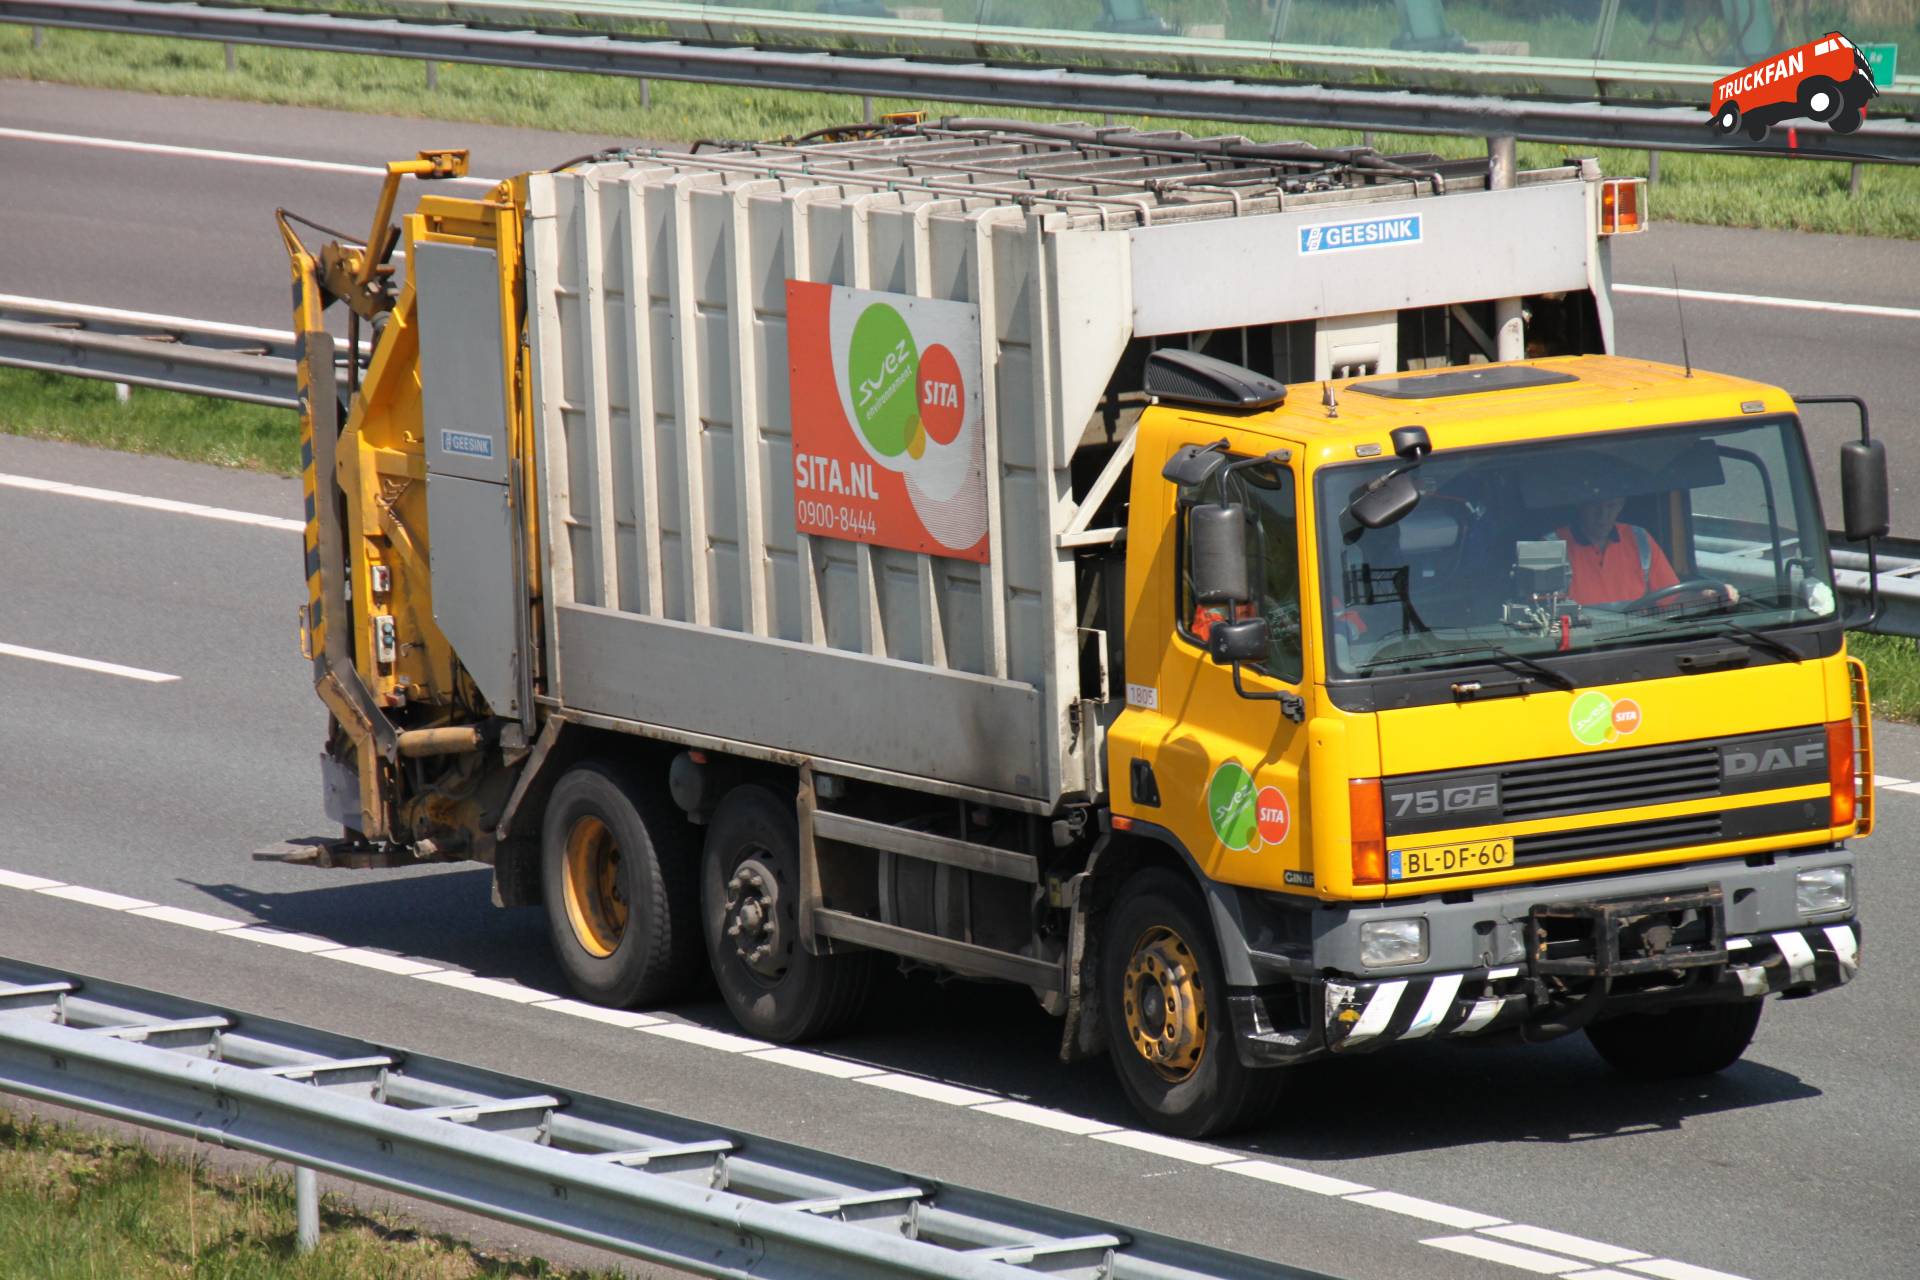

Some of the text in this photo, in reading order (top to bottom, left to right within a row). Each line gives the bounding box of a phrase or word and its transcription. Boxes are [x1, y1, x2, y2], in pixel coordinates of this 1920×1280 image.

[1326, 219, 1412, 245] GEESINK
[924, 380, 958, 408] SITA
[453, 435, 489, 454] GEESINK
[796, 453, 879, 500] SITA.NL
[798, 500, 877, 535] 0900-8444
[1130, 687, 1154, 706] 1805
[1615, 711, 1637, 722] SITA
[1723, 743, 1825, 776] DAF
[1391, 786, 1496, 816] 75 CF
[1260, 807, 1285, 824] SITA
[1408, 843, 1505, 874] BL-DF-60
